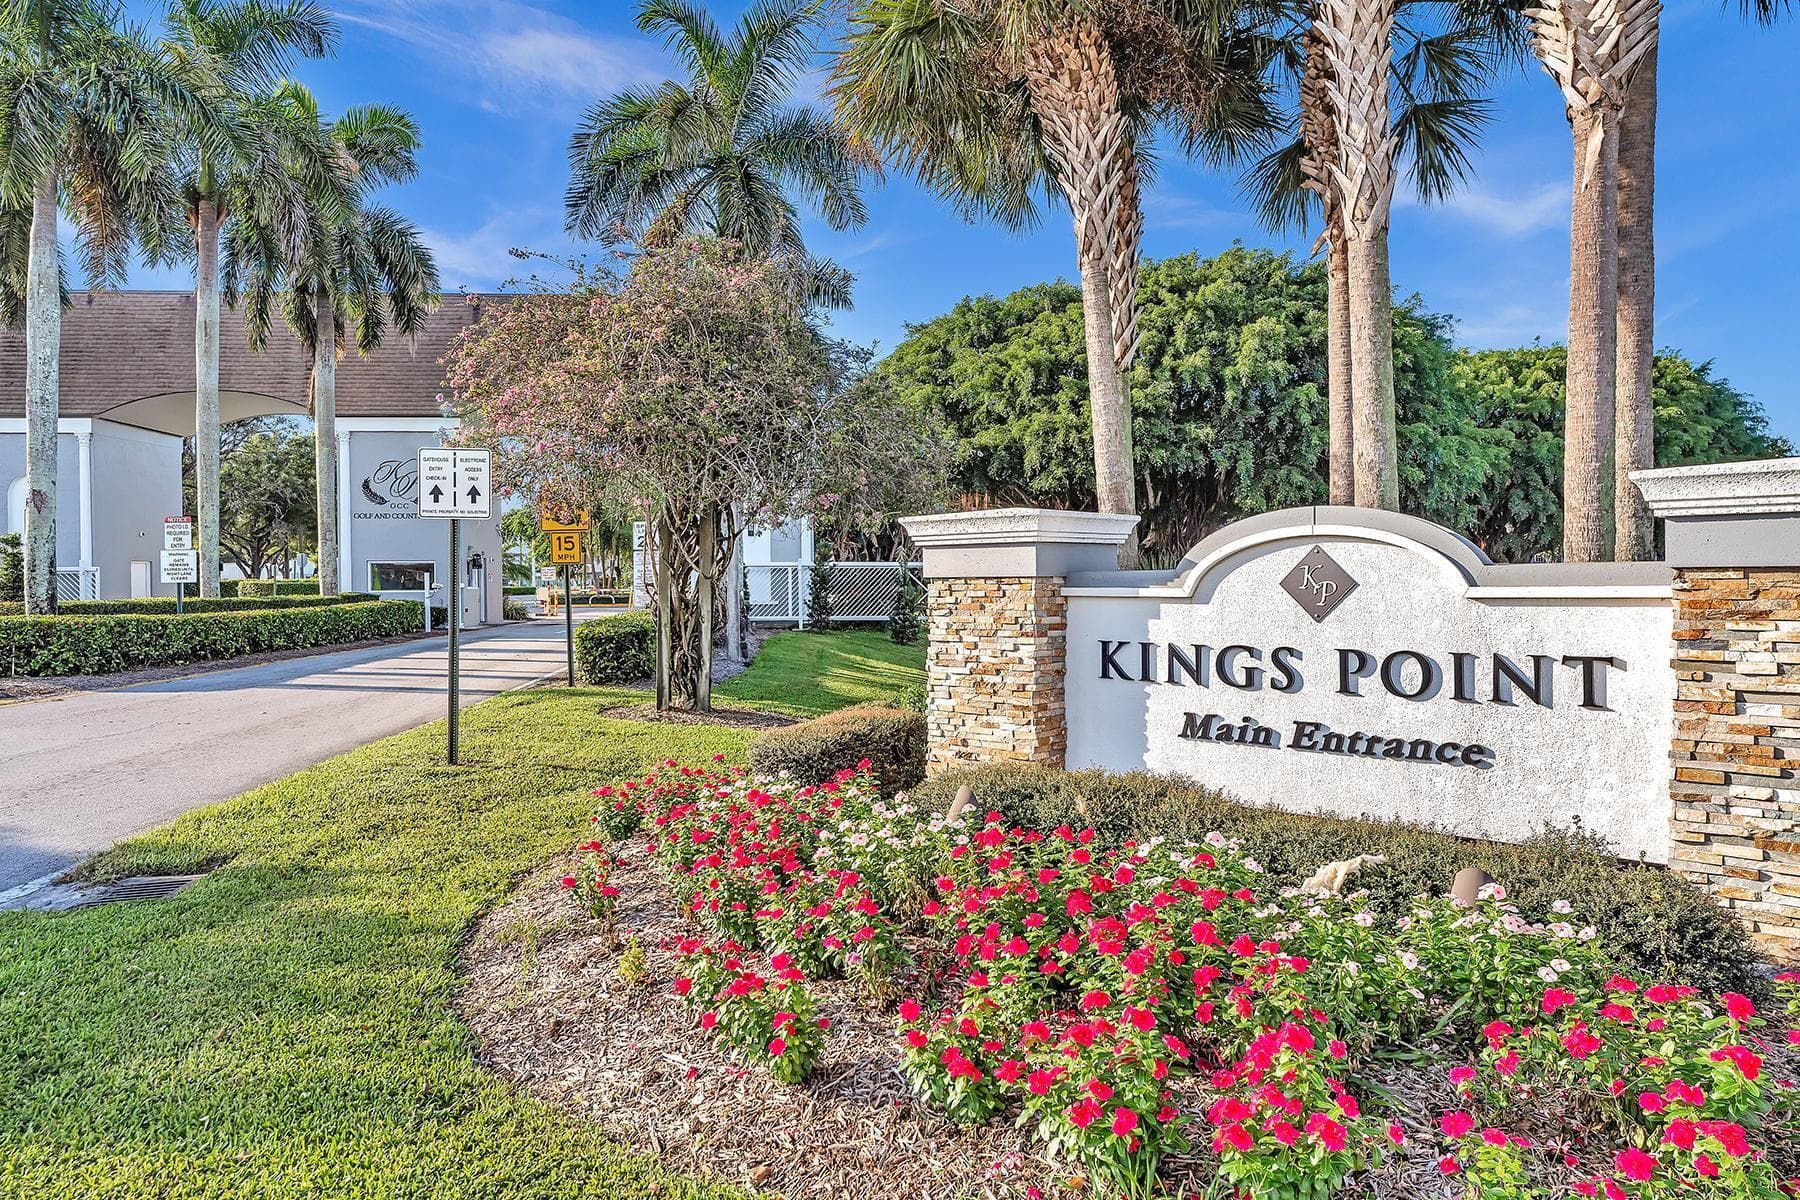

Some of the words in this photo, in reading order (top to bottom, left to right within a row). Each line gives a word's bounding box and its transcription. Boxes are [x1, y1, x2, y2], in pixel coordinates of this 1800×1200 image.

[353, 512, 373, 520] GOLF
[373, 512, 391, 520] AND
[391, 512, 420, 520] COUNT
[555, 535, 576, 552] 15
[557, 553, 576, 561] MPH
[1097, 639, 1303, 694] KINGS
[1334, 648, 1622, 710] POINT
[1177, 711, 1281, 750] Main
[1286, 720, 1496, 769] Entrance
